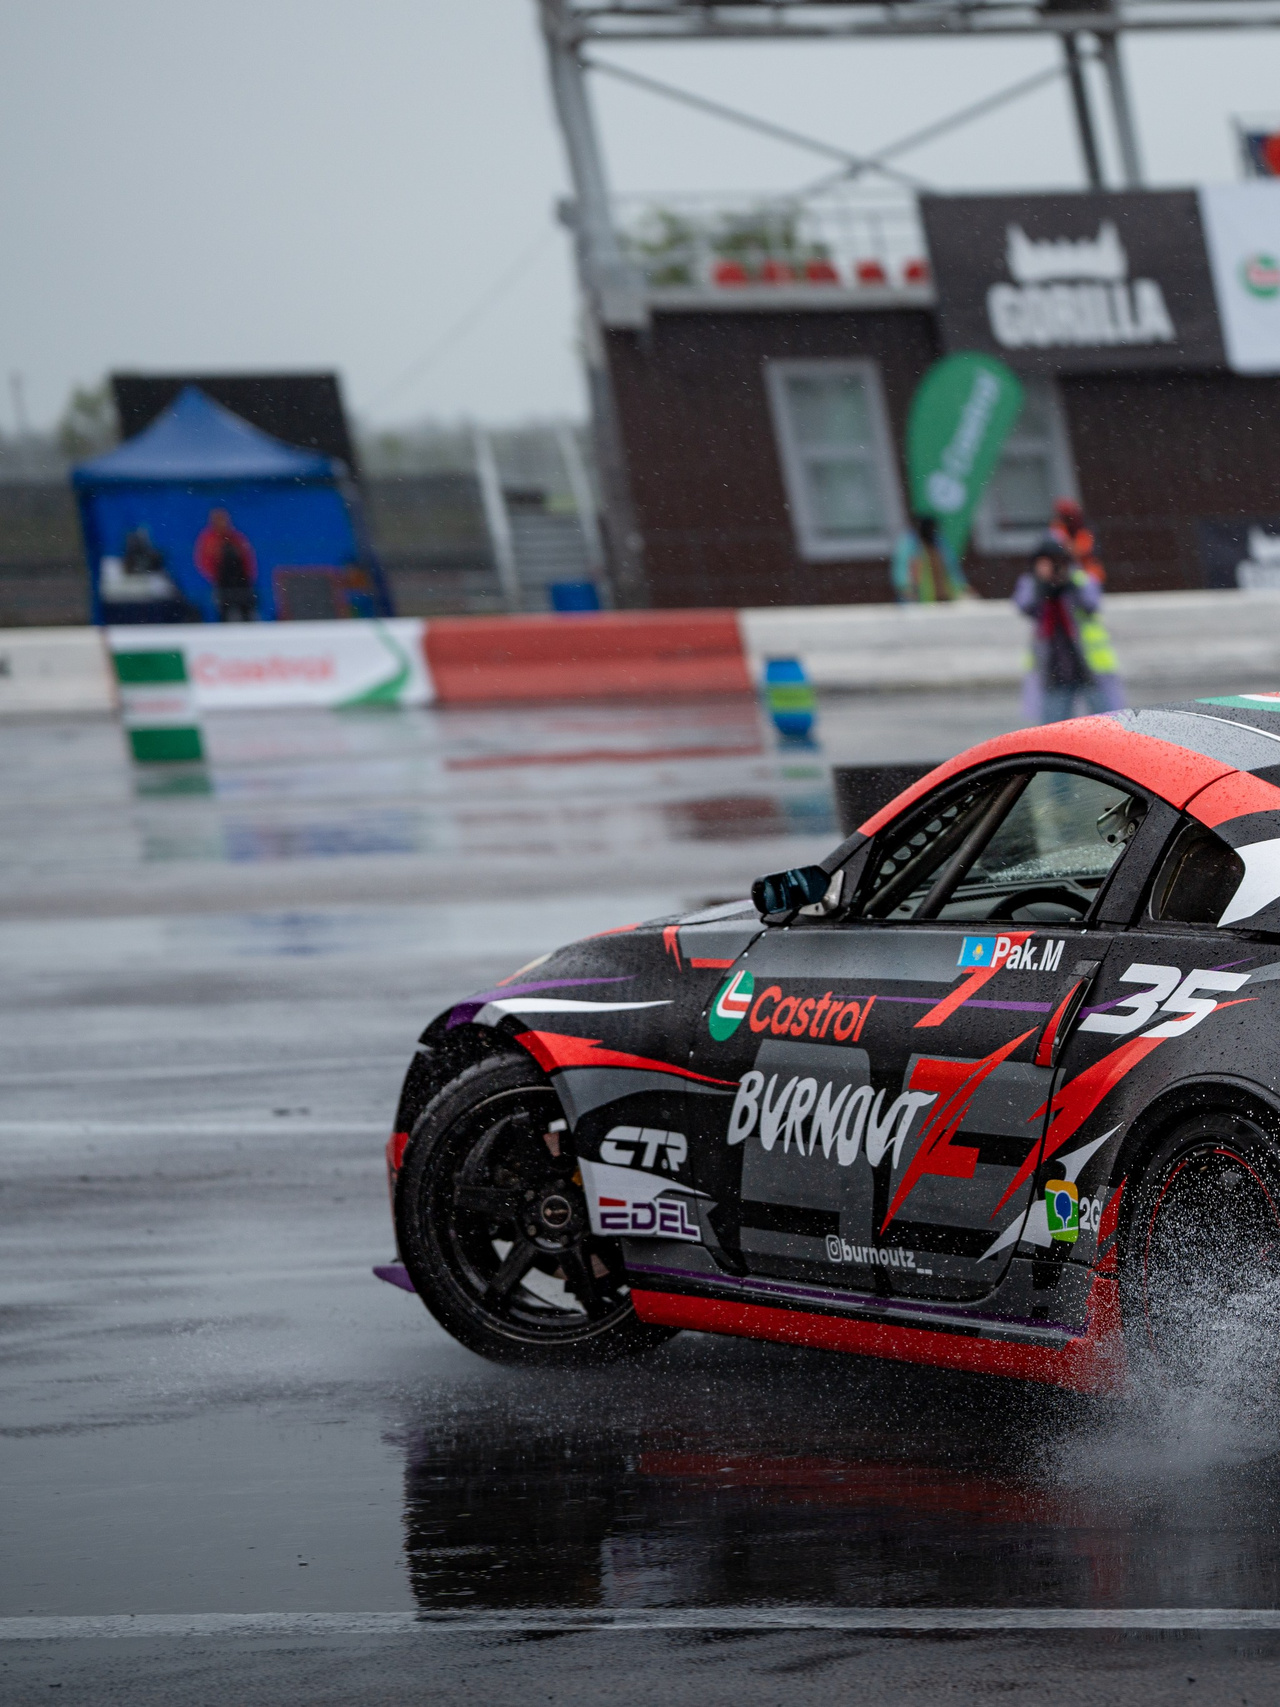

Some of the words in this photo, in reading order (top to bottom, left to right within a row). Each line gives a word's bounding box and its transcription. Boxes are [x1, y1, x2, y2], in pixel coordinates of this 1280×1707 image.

[985, 278, 1176, 349] GORILLA
[992, 936, 1066, 973] Pak.M
[749, 984, 877, 1043] Castrol
[1078, 962, 1252, 1039] 35
[599, 1125, 689, 1172] CTR
[598, 1196, 699, 1237] EDEL
[1079, 1196, 1103, 1233] 2G
